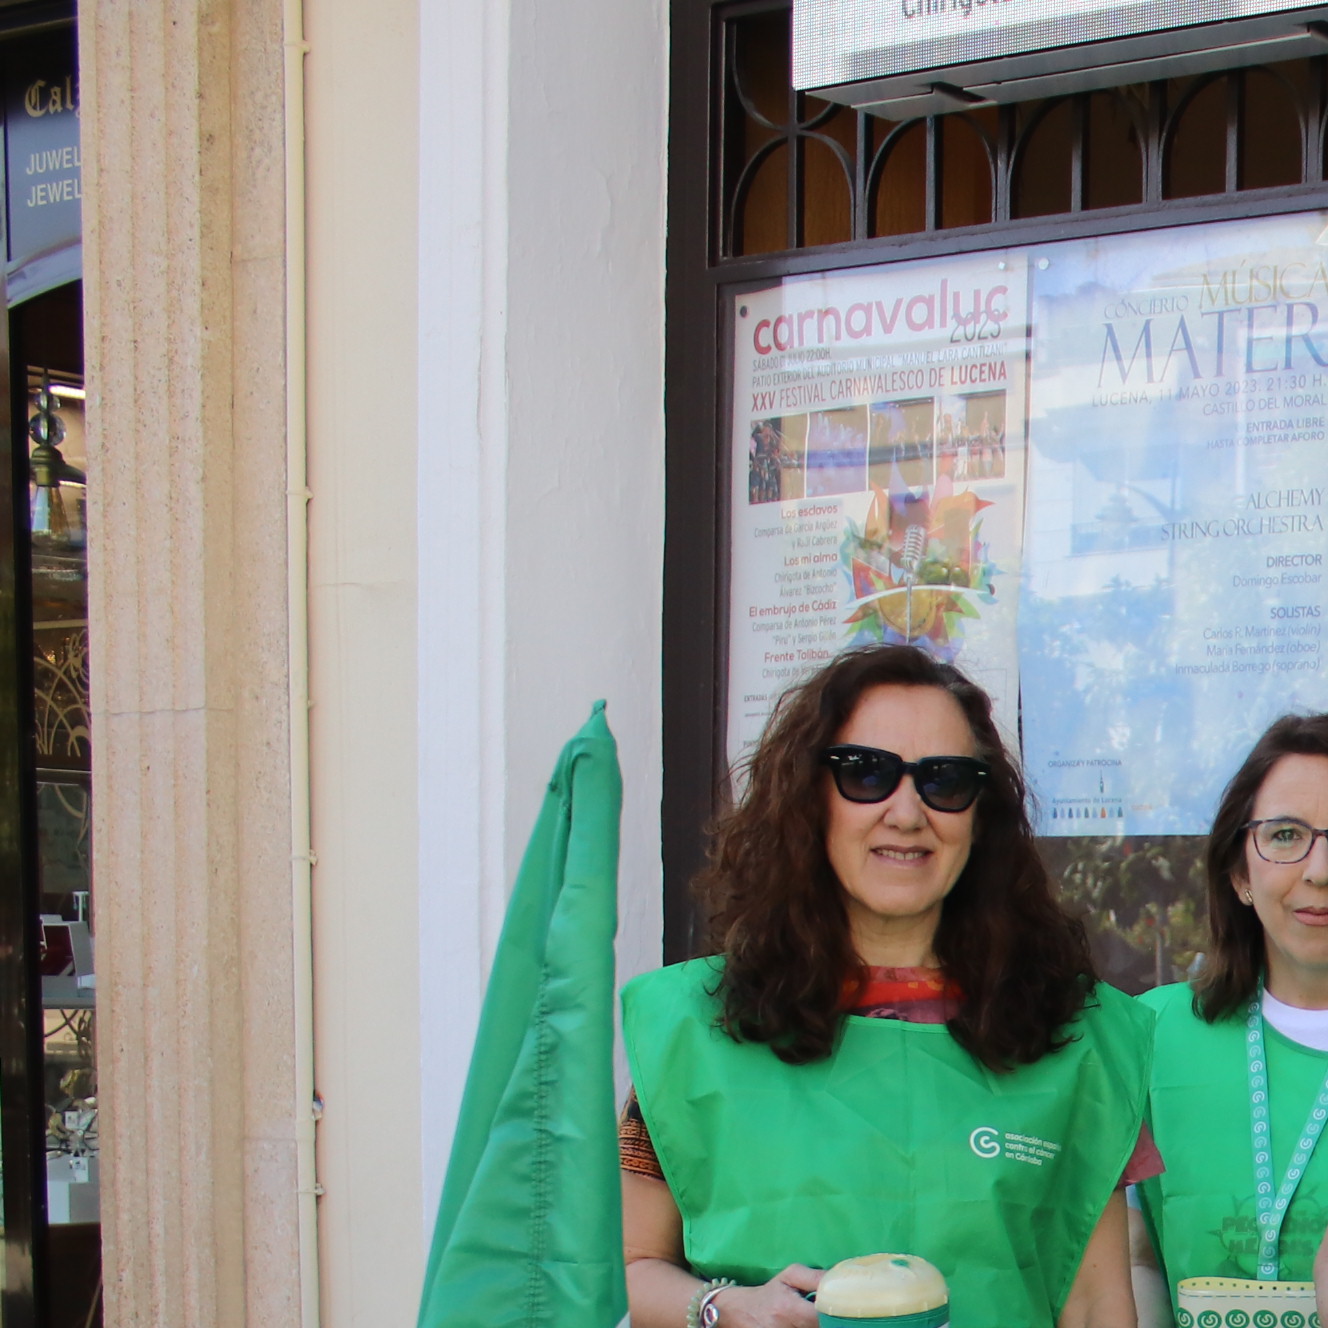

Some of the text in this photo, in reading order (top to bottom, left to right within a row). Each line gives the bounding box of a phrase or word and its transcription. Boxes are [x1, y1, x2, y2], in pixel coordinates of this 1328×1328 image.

[1104, 295, 1189, 320] CONCIERTO
[754, 279, 1008, 354] carnavaluc
[951, 309, 1001, 343] 2023
[752, 372, 771, 387] PATIO
[773, 368, 802, 385] EXTERIOR
[803, 366, 815, 380] DEL
[816, 361, 854, 379] AUDITORIO
[856, 357, 895, 374] MUNICIPAL
[752, 361, 1007, 412] XXV FESTIVAL CARNAVALESCO DE LUCENA
[1092, 391, 1152, 407] LUCENA,
[1160, 388, 1172, 402] 11
[1179, 383, 1220, 401] MAYO
[1267, 375, 1306, 392] 21:30
[1203, 394, 1327, 416] CASTILLO DEL MORAL
[1246, 417, 1325, 433] ENTRADA LIBRE
[1207, 431, 1325, 450] HASTA COMPLETAR AFORO
[1246, 488, 1325, 510] ALCHEMY
[782, 504, 838, 519] Los esclavos
[754, 526, 784, 538] Comparsa
[1161, 514, 1323, 541] STRING ORCHESTRA
[812, 536, 837, 546] Cabrera
[784, 553, 837, 566] Los mi alma
[1266, 554, 1322, 568] DIRECTOR
[775, 568, 837, 584] Chirigota Antonio
[1233, 572, 1322, 589] Domingo Escobar
[749, 600, 837, 620] El embrujo de Cádiz
[1270, 606, 1320, 619] SOLISTAS
[753, 616, 837, 633] Comparsa de Antonio Pérez
[798, 632, 817, 644] Sergio
[1203, 627, 1233, 639] Carlos
[1235, 641, 1320, 655] Fernández (oboe)
[765, 652, 795, 663] Frente
[762, 668, 790, 679] Chirigota
[1176, 659, 1320, 675] Inmaculada Borrego (soprano)
[1005, 1132, 1042, 1146] asociación
